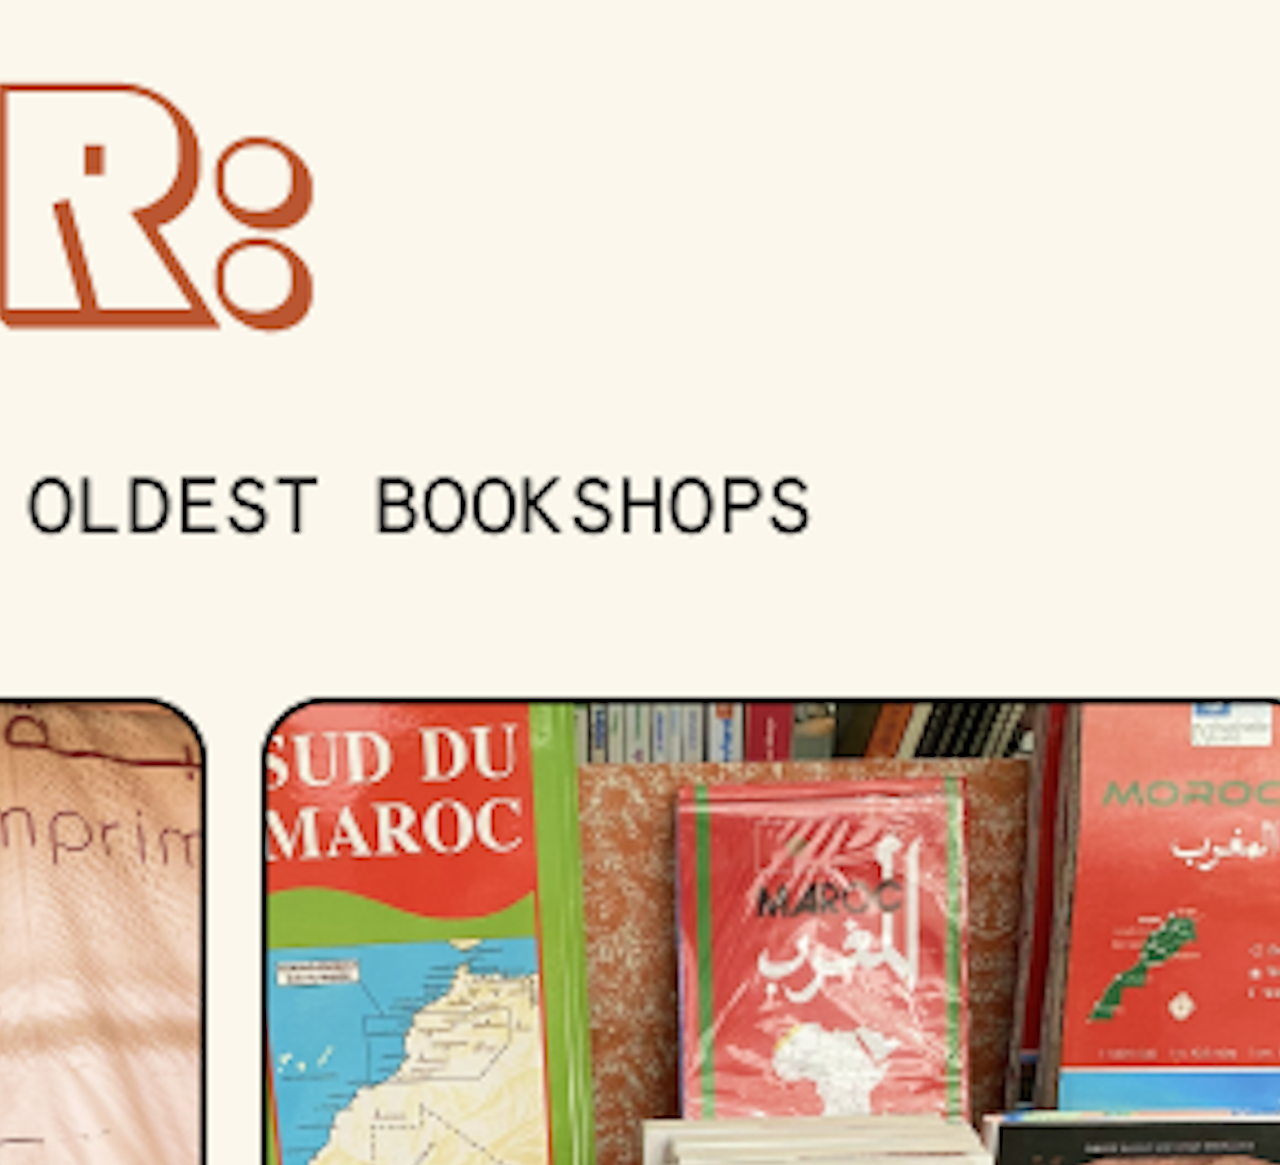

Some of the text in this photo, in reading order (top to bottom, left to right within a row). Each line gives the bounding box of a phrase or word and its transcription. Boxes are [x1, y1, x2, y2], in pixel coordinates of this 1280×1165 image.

[421, 723, 518, 783] DU
[266, 796, 523, 861] MAROC
[757, 880, 902, 917] MAROC
